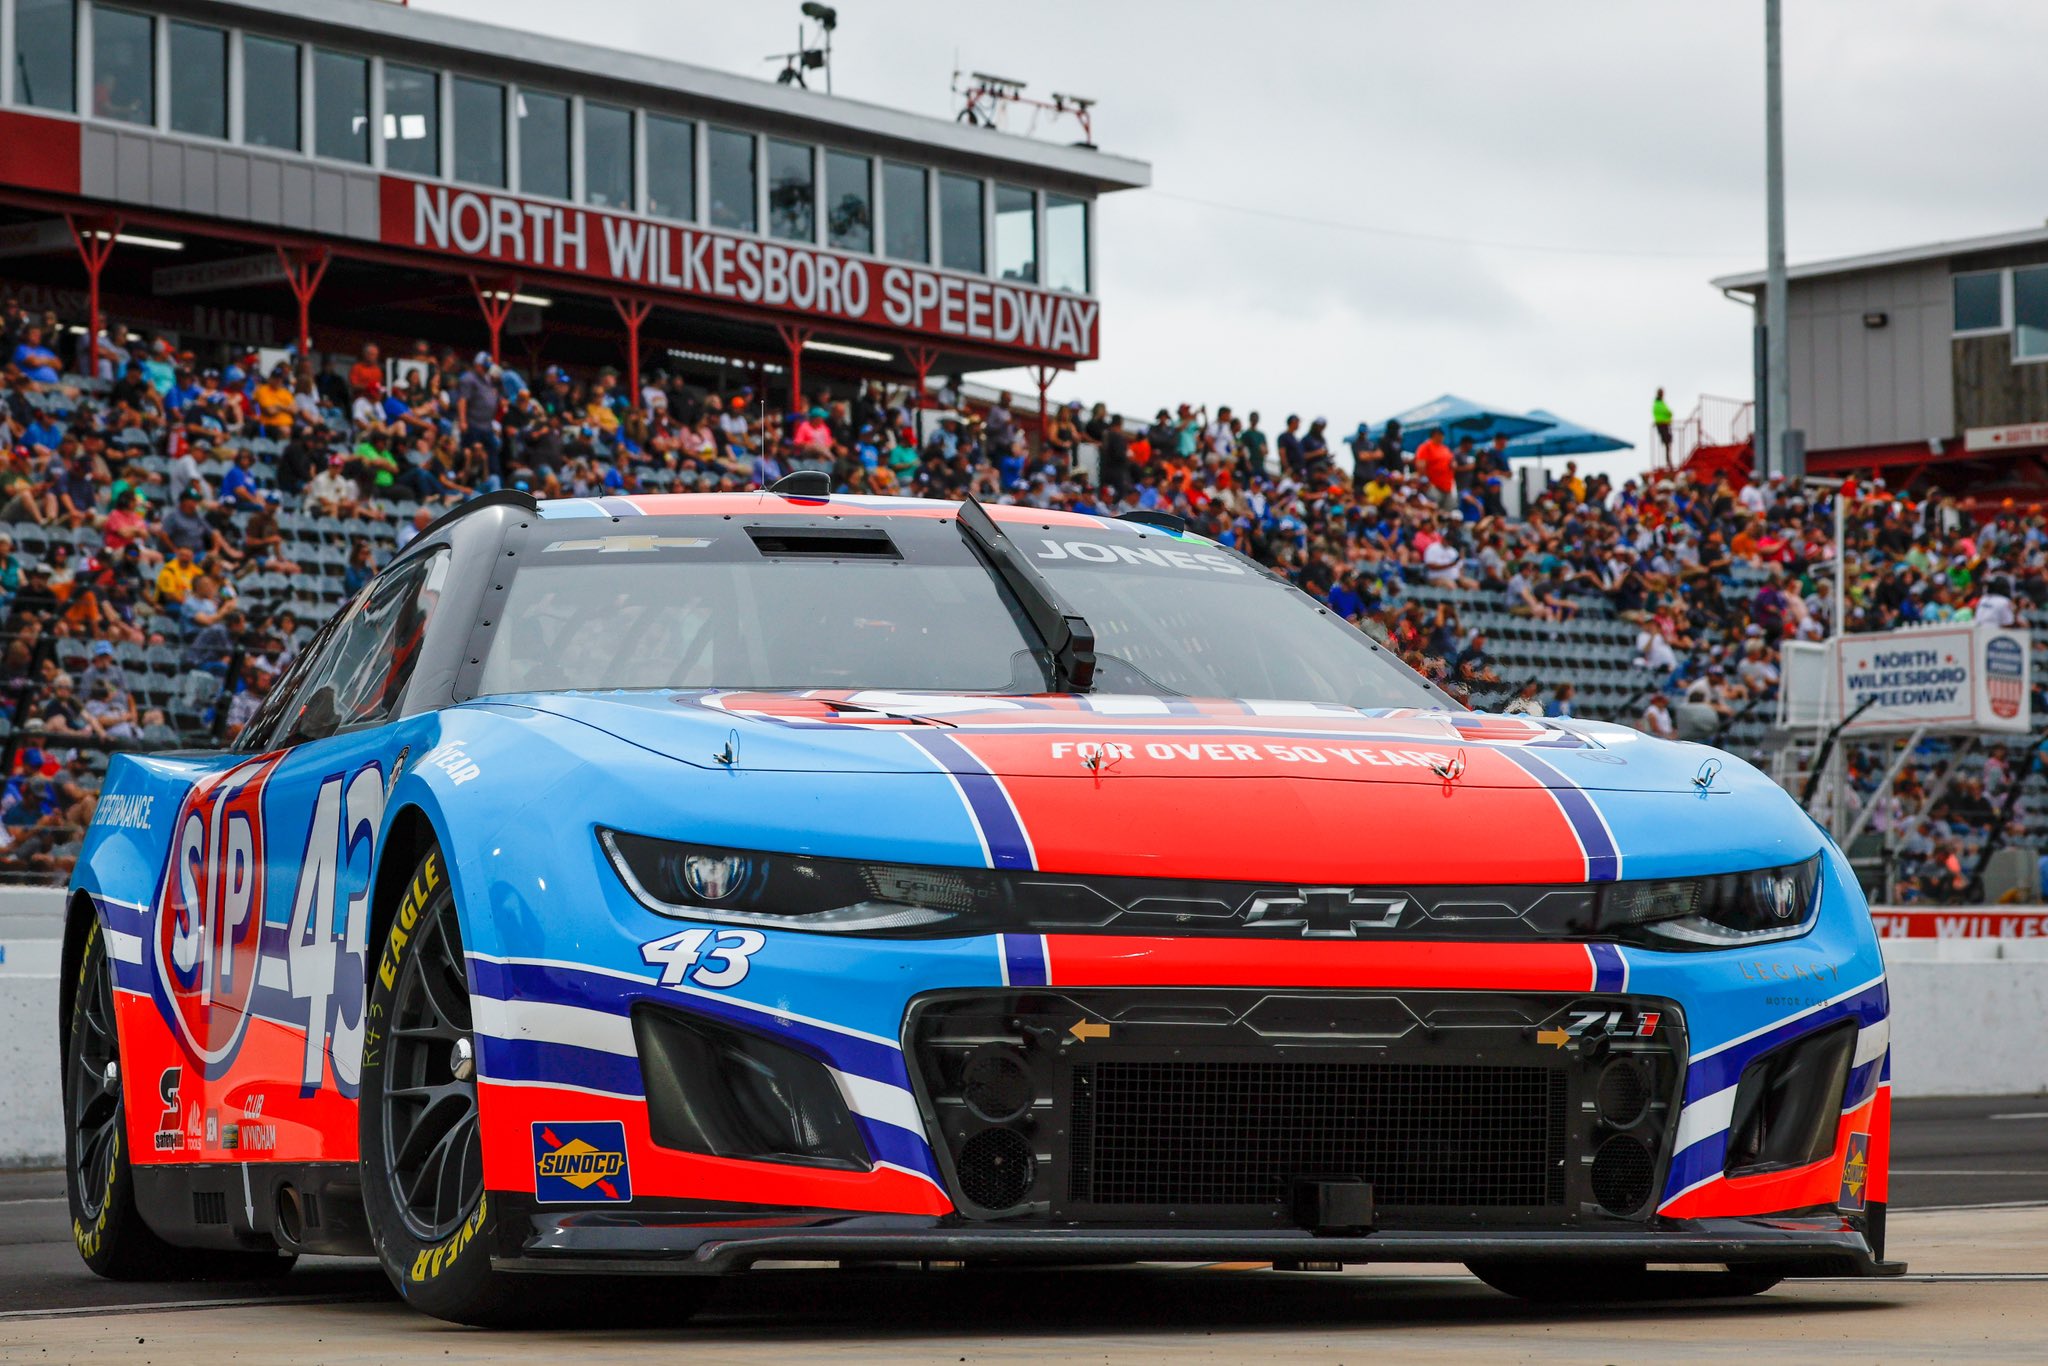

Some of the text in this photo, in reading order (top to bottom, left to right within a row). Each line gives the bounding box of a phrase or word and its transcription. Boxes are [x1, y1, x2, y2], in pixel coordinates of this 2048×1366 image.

[414, 183, 1097, 356] NORTH WILKESBORO SPEEDWAY
[1037, 539, 1245, 575] JONES
[1874, 651, 1938, 669] NORTH
[1847, 667, 1966, 690] WILKESBORO
[1856, 687, 1957, 706] SPEEDWAY
[1051, 742, 1461, 769] FOR OVER 50 YEARS
[171, 760, 272, 1006] STP
[288, 762, 384, 1088] 43
[379, 853, 440, 992] EAGLE
[640, 929, 766, 988] 43
[1738, 962, 1838, 982] LEGACY
[1765, 996, 1829, 1008] MOTOR CLUB
[362, 1003, 384, 1068] R43
[1566, 1011, 1661, 1037] ZL1
[244, 1094, 264, 1119] CLUB
[242, 1124, 276, 1150] WYNDHAM
[541, 1154, 621, 1174] SUNOCO
